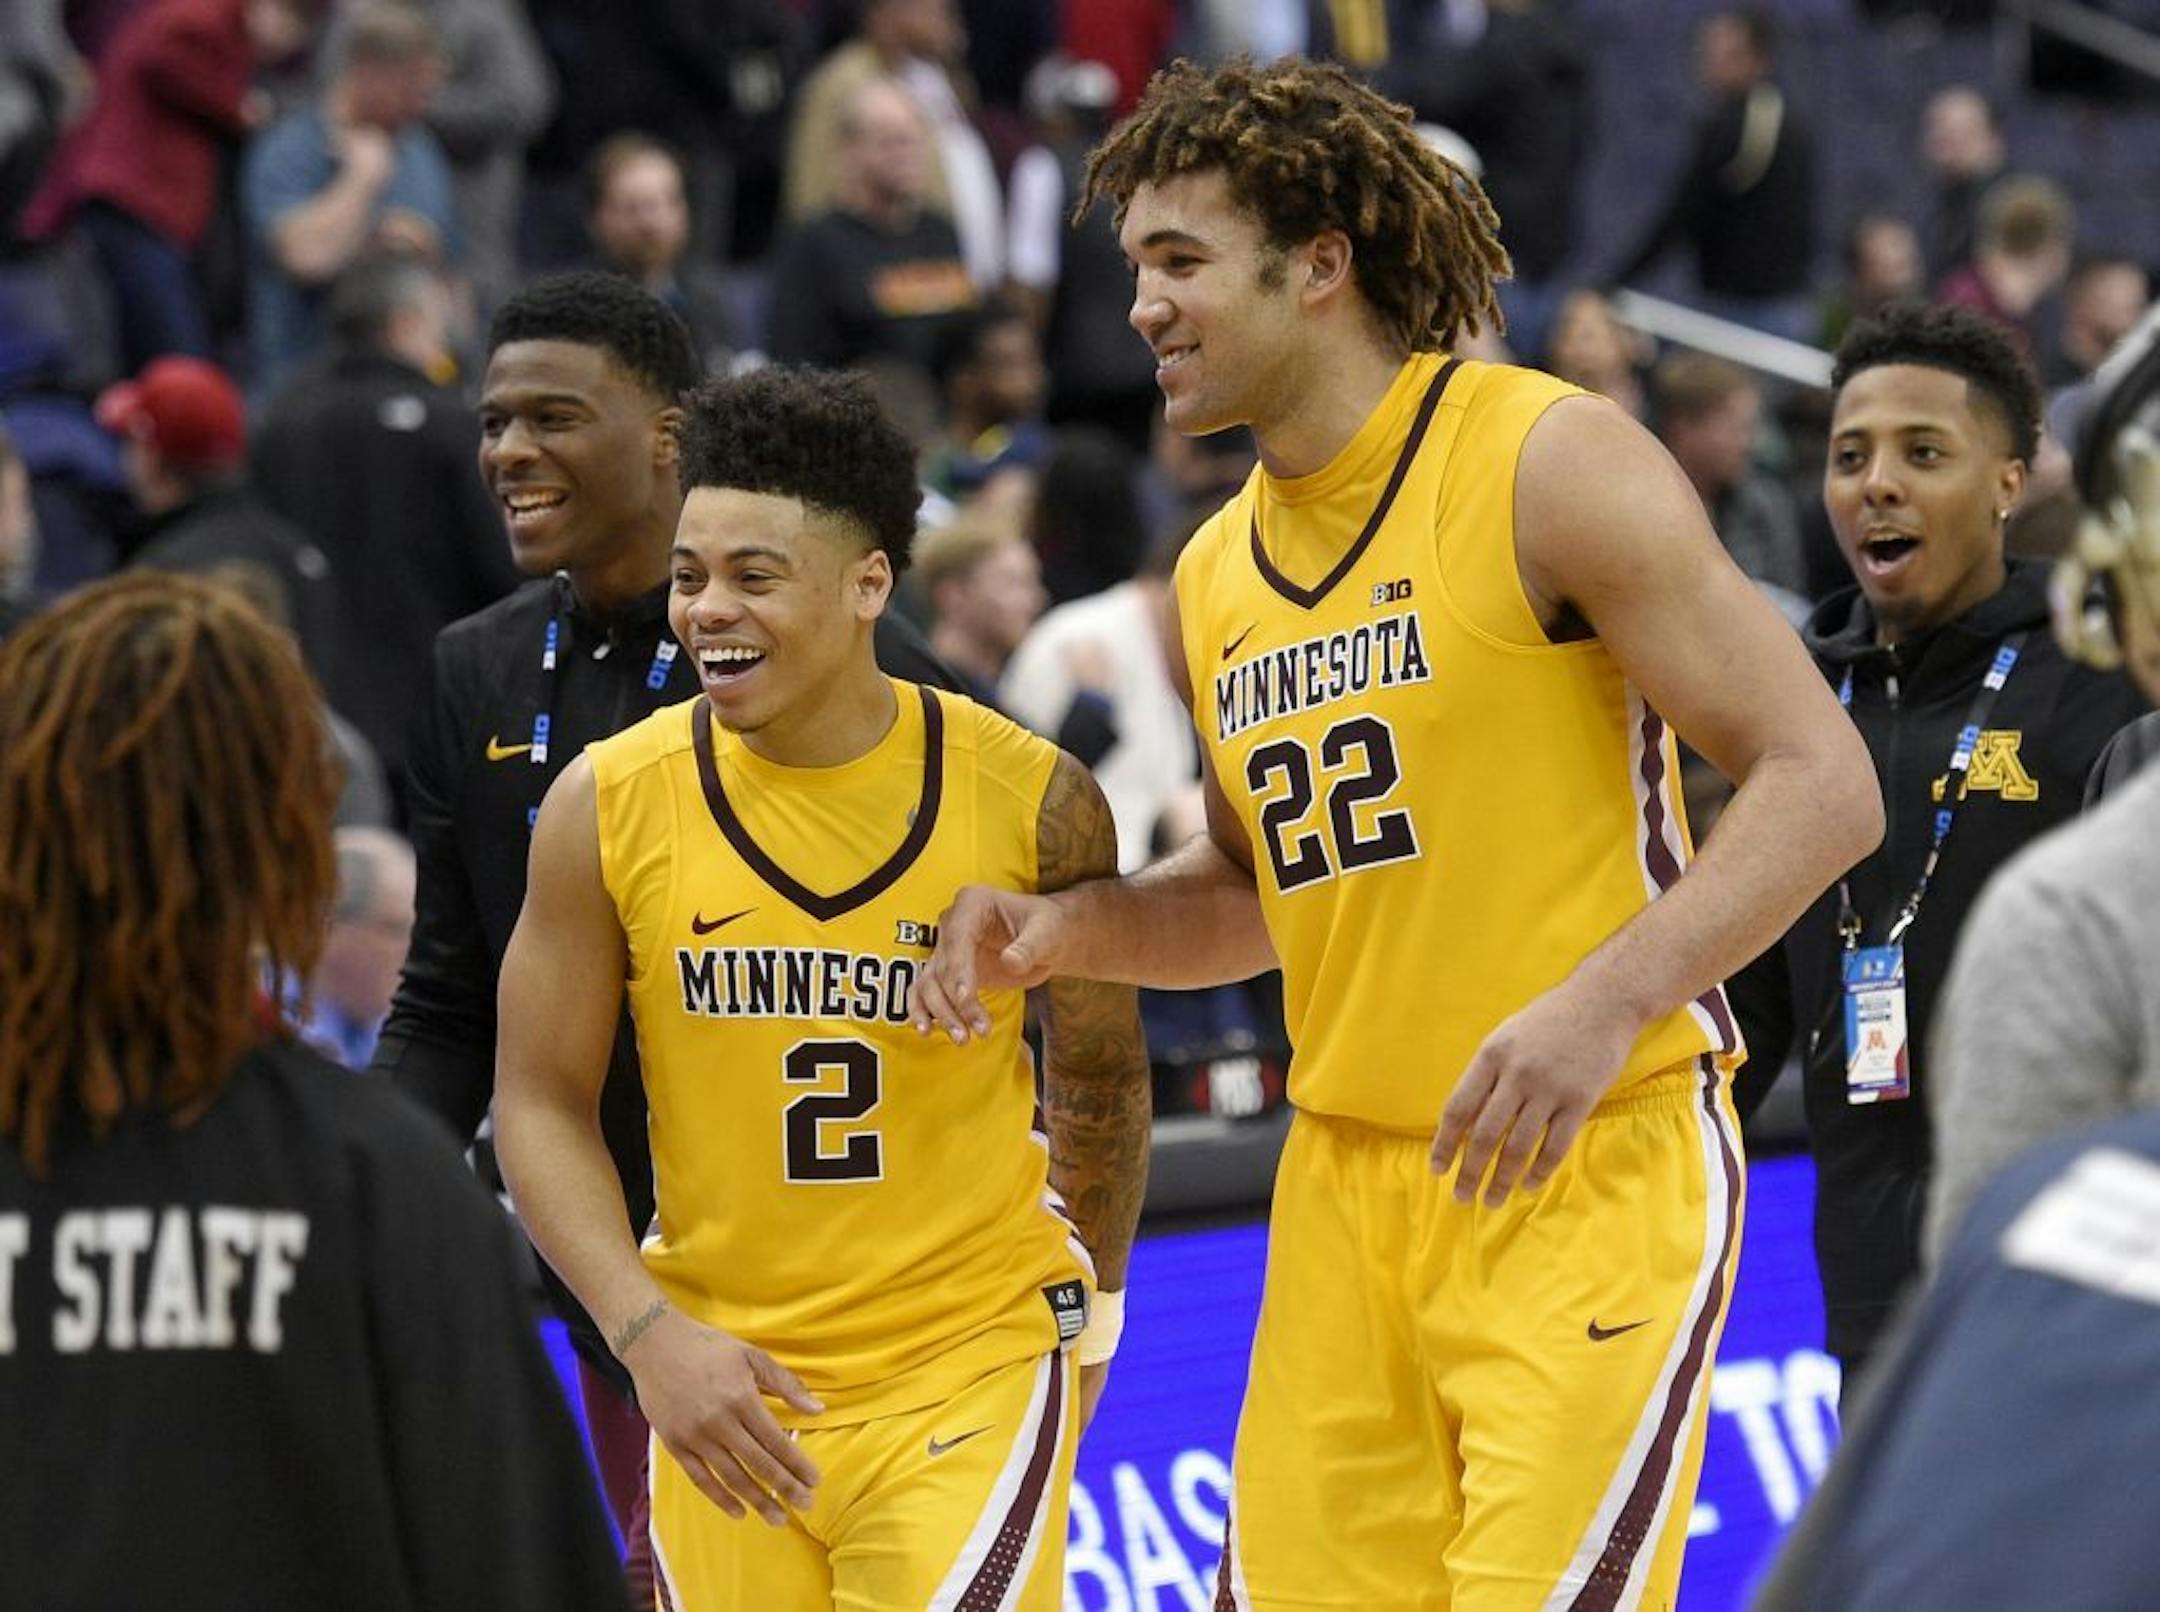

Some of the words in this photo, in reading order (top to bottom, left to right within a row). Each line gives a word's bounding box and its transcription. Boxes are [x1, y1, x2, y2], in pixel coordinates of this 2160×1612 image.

[1214, 611, 1432, 744] MINNESOTA
[1246, 713, 1422, 896] 22
[676, 948, 920, 1024] MINNESO
[781, 1037, 884, 1184] 2
[52, 1207, 309, 1353] STAFF
